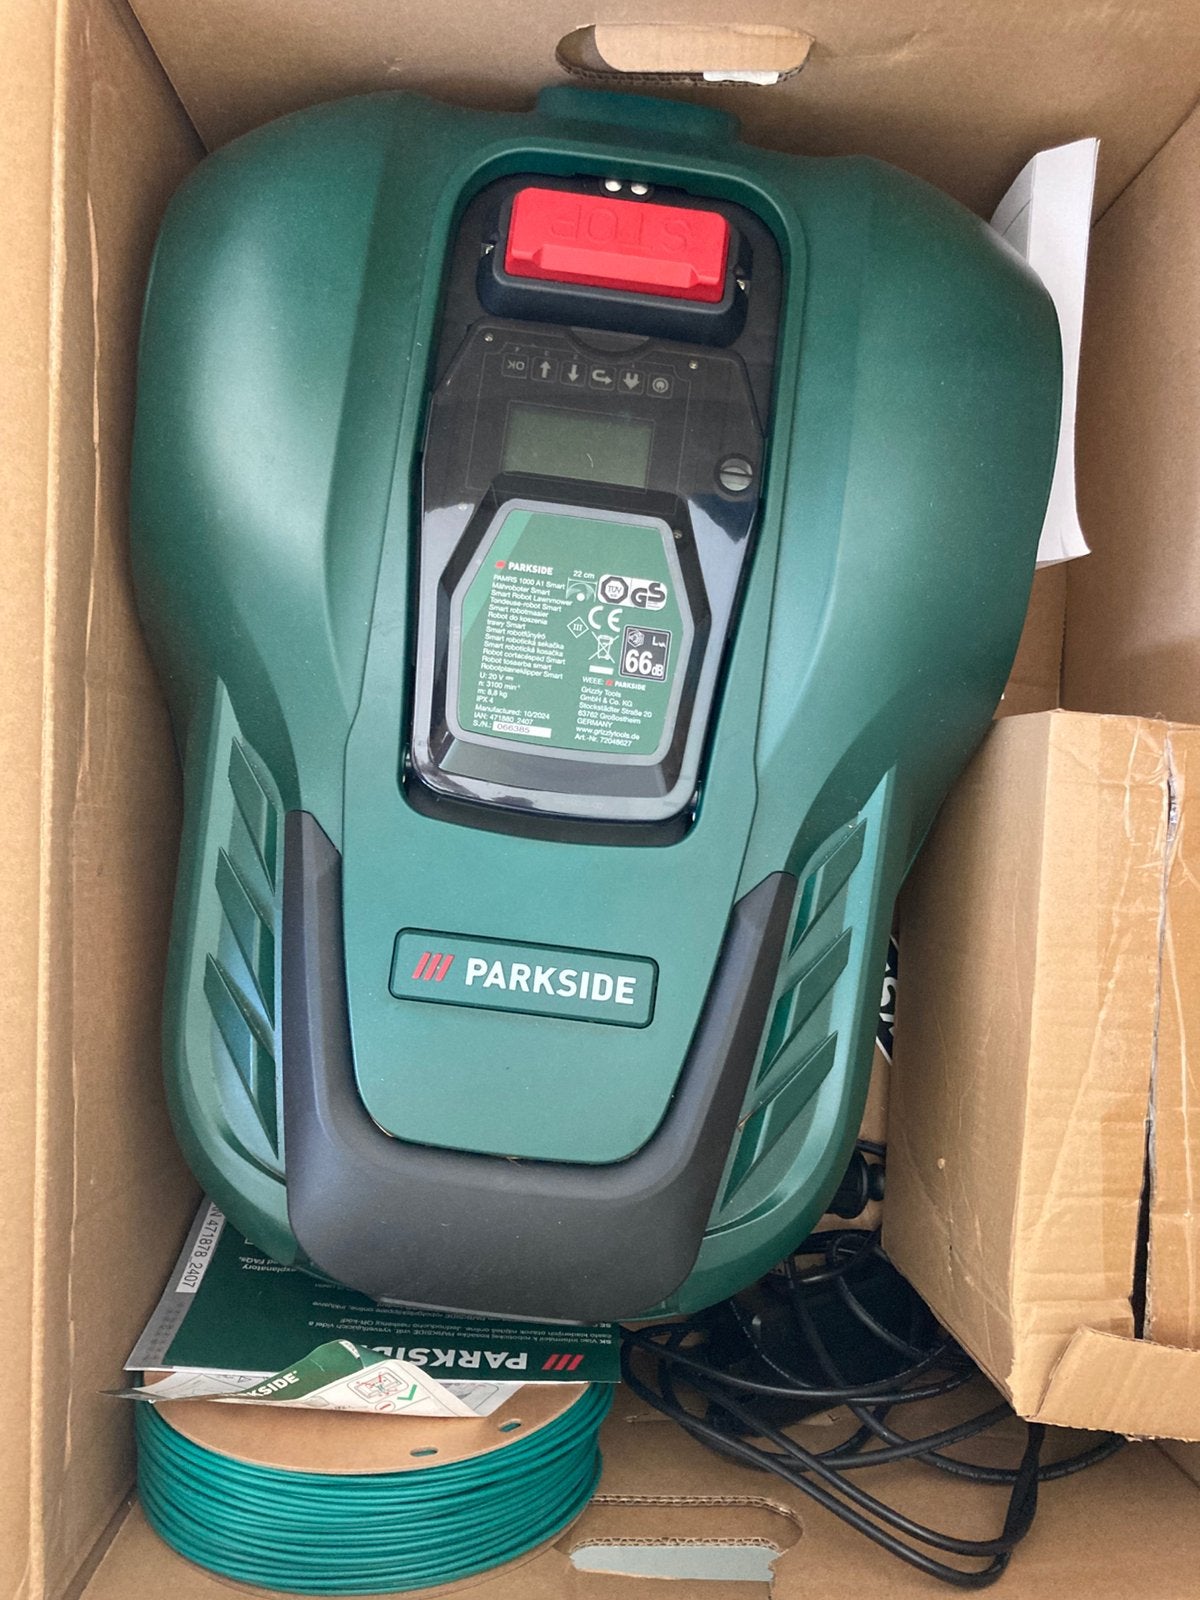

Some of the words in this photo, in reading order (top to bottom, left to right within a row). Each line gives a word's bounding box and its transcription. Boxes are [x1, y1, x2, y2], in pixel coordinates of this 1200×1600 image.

[551, 204, 691, 251] STOP
[507, 360, 525, 370] OK
[508, 562, 554, 576] PARKSIDE
[519, 578, 535, 586] 1000
[546, 581, 566, 590] Smart
[530, 586, 551, 596] Smart
[631, 583, 666, 608] GS
[491, 589, 511, 598] Smart
[512, 592, 532, 600] Robot
[533, 595, 573, 606] Lawnmower
[489, 604, 509, 613] Smart
[542, 604, 562, 612] Smart
[488, 611, 508, 620] Robot
[486, 626, 506, 634] Smart
[506, 621, 526, 630] Smart
[485, 633, 505, 642] Smart
[484, 640, 504, 649] Smart
[483, 648, 503, 656] Robot
[546, 656, 566, 665] Smart
[482, 655, 502, 664] Robot
[533, 662, 552, 671] smart
[626, 648, 653, 675] 66
[652, 664, 664, 676] dB
[543, 671, 564, 680] Smart
[486, 681, 503, 689] 3100
[614, 681, 646, 691] PARKSIDE
[499, 691, 508, 699] kg
[581, 686, 603, 696] Grizzly
[604, 689, 622, 698] Tools
[580, 694, 602, 702] GmbH
[609, 698, 620, 706] Co.
[622, 700, 633, 708] KG
[524, 710, 550, 720] 10/2024
[578, 710, 598, 718] 63762
[621, 708, 642, 717] Straße
[577, 718, 613, 728] GERMANY
[497, 724, 530, 733] 066385
[465, 958, 637, 1005] PARKSIDE
